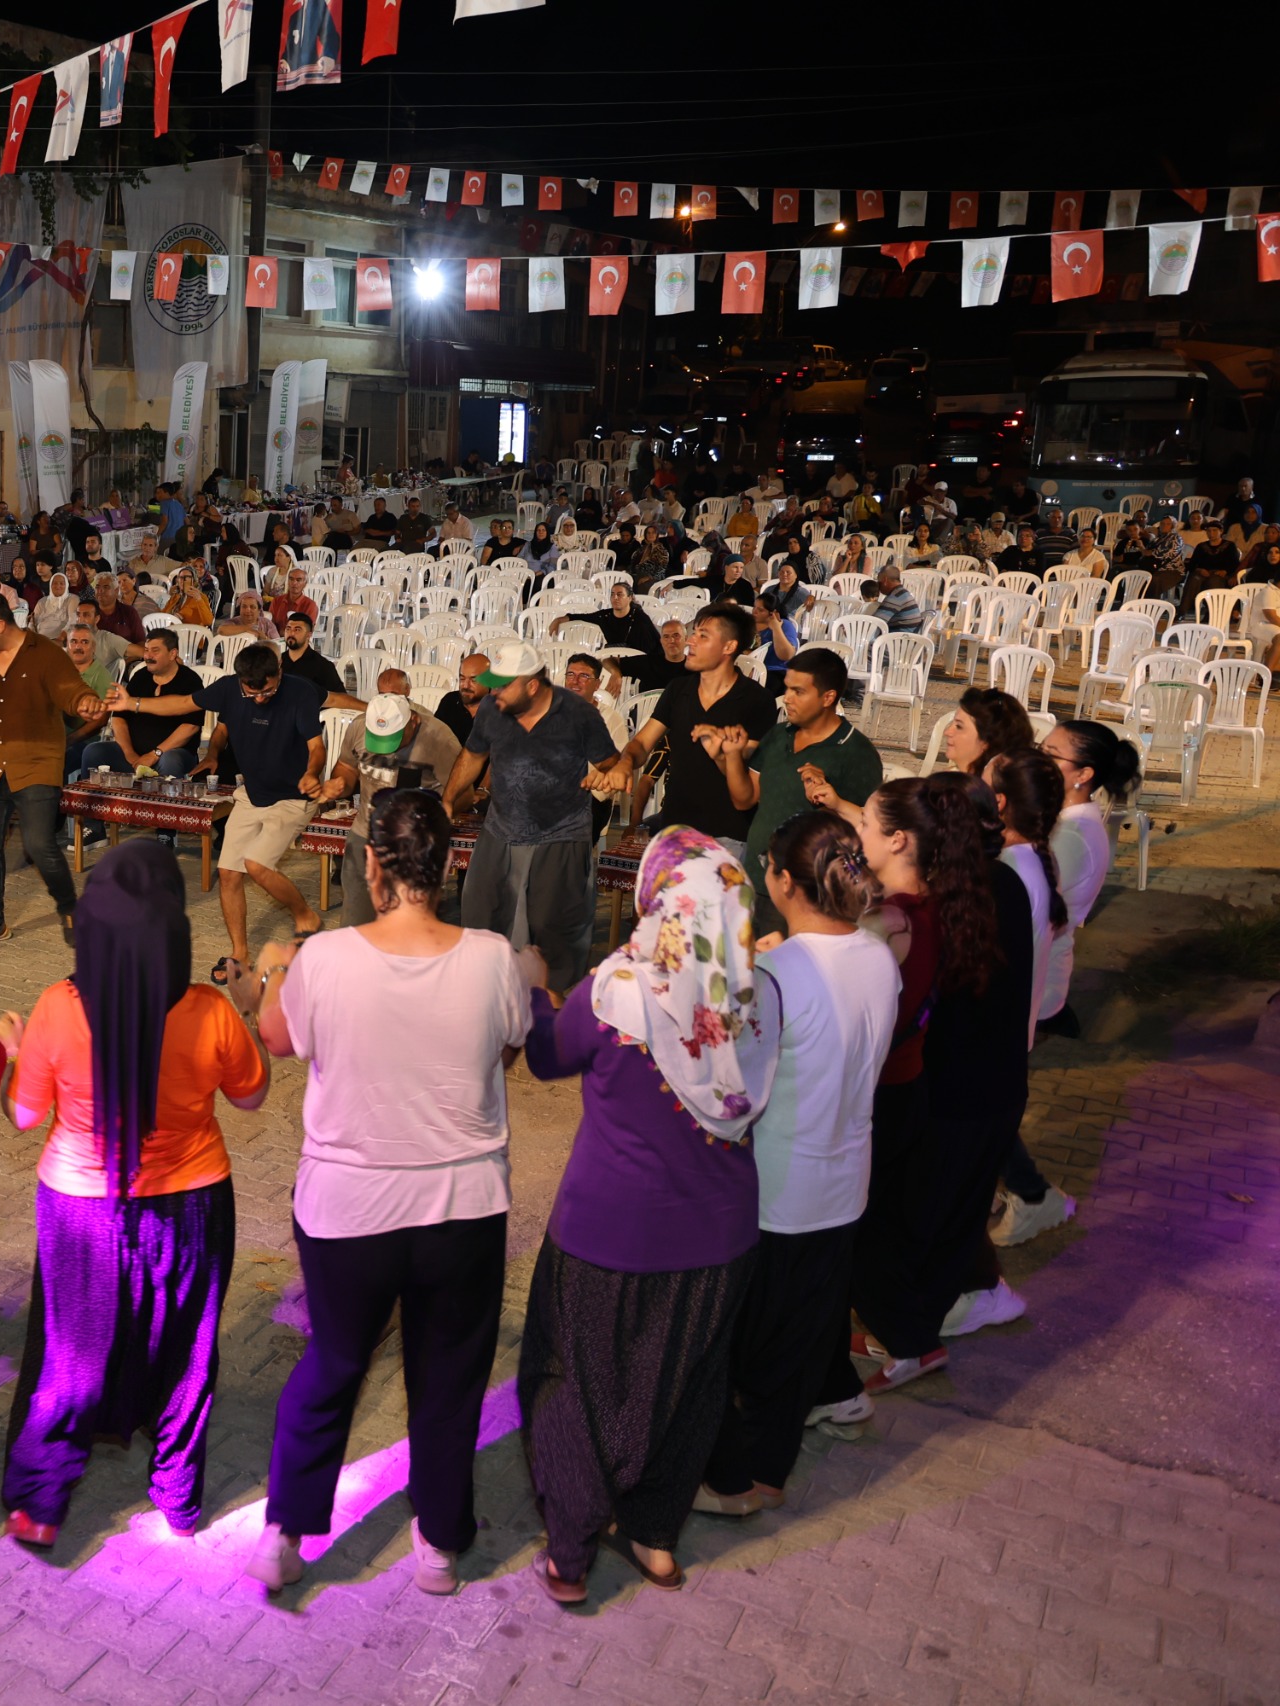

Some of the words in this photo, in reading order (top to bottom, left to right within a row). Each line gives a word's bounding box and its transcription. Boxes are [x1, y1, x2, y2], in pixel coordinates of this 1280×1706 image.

[157, 227, 202, 253] TOROSLAR
[179, 321, 203, 332] 1994
[182, 375, 194, 430] BELEDİYESİ
